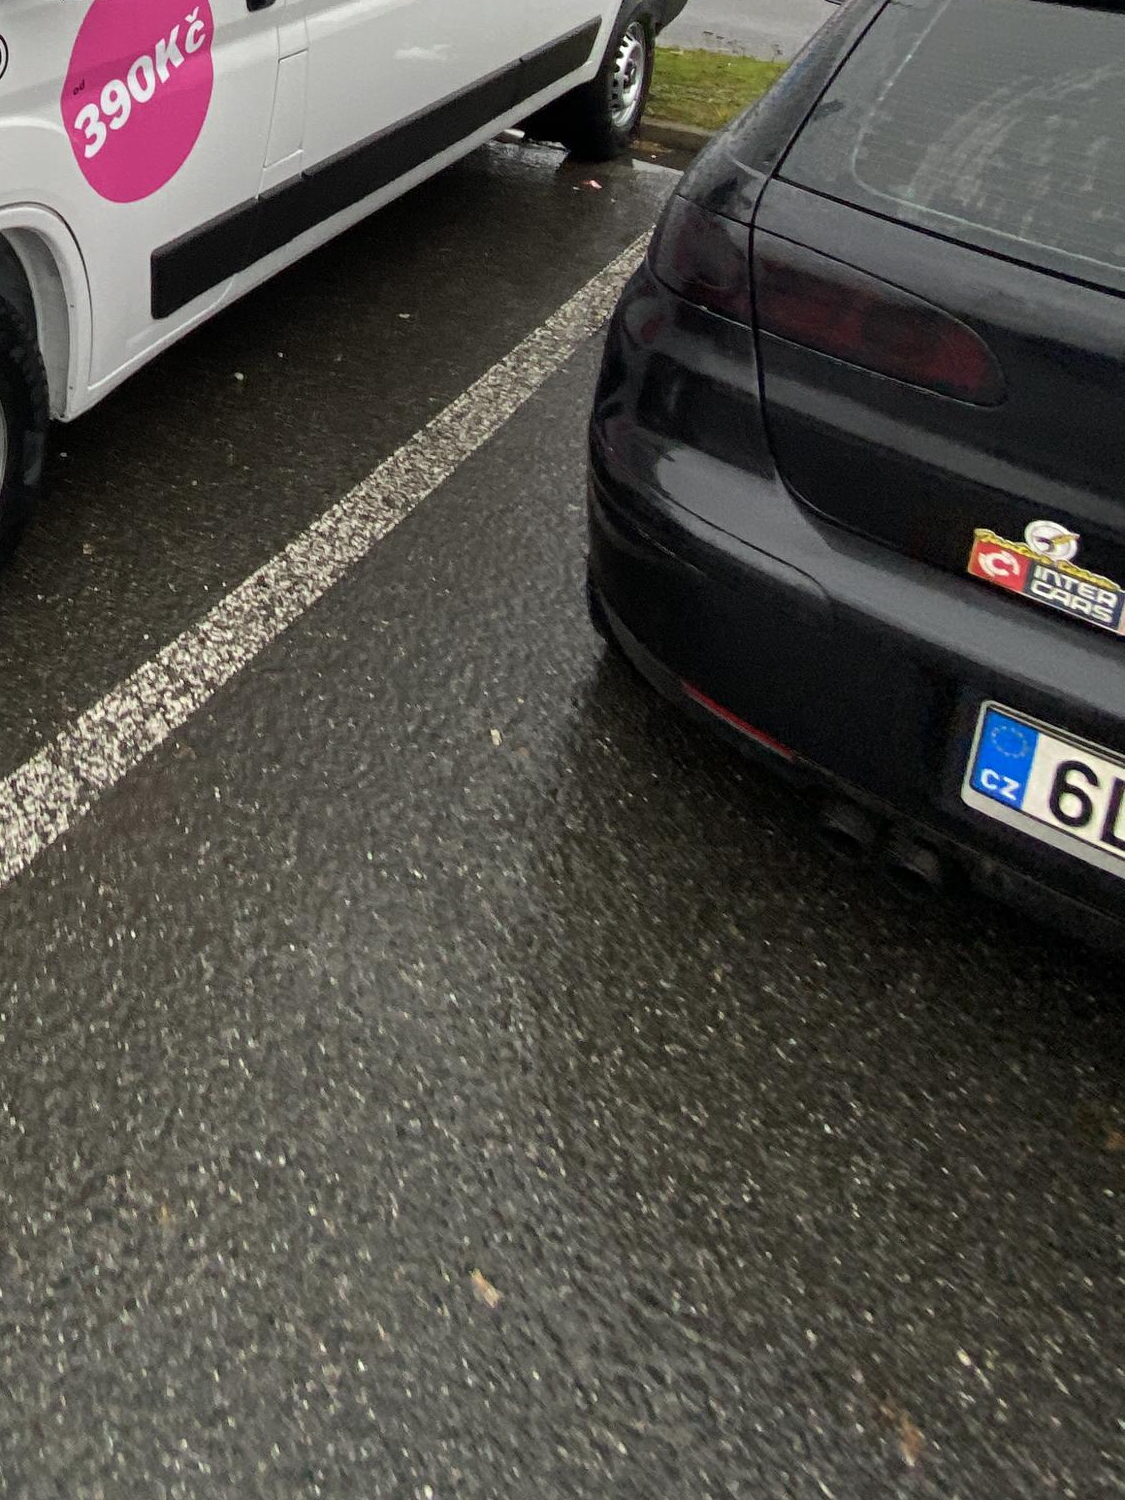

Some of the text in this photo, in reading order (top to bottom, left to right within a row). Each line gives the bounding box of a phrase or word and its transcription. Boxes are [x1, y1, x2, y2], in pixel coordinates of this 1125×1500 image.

[74, 6, 206, 158] 390Kč
[1030, 579, 1114, 622] CARS
[1033, 564, 1118, 608] INTER
[981, 768, 1020, 801] CZ
